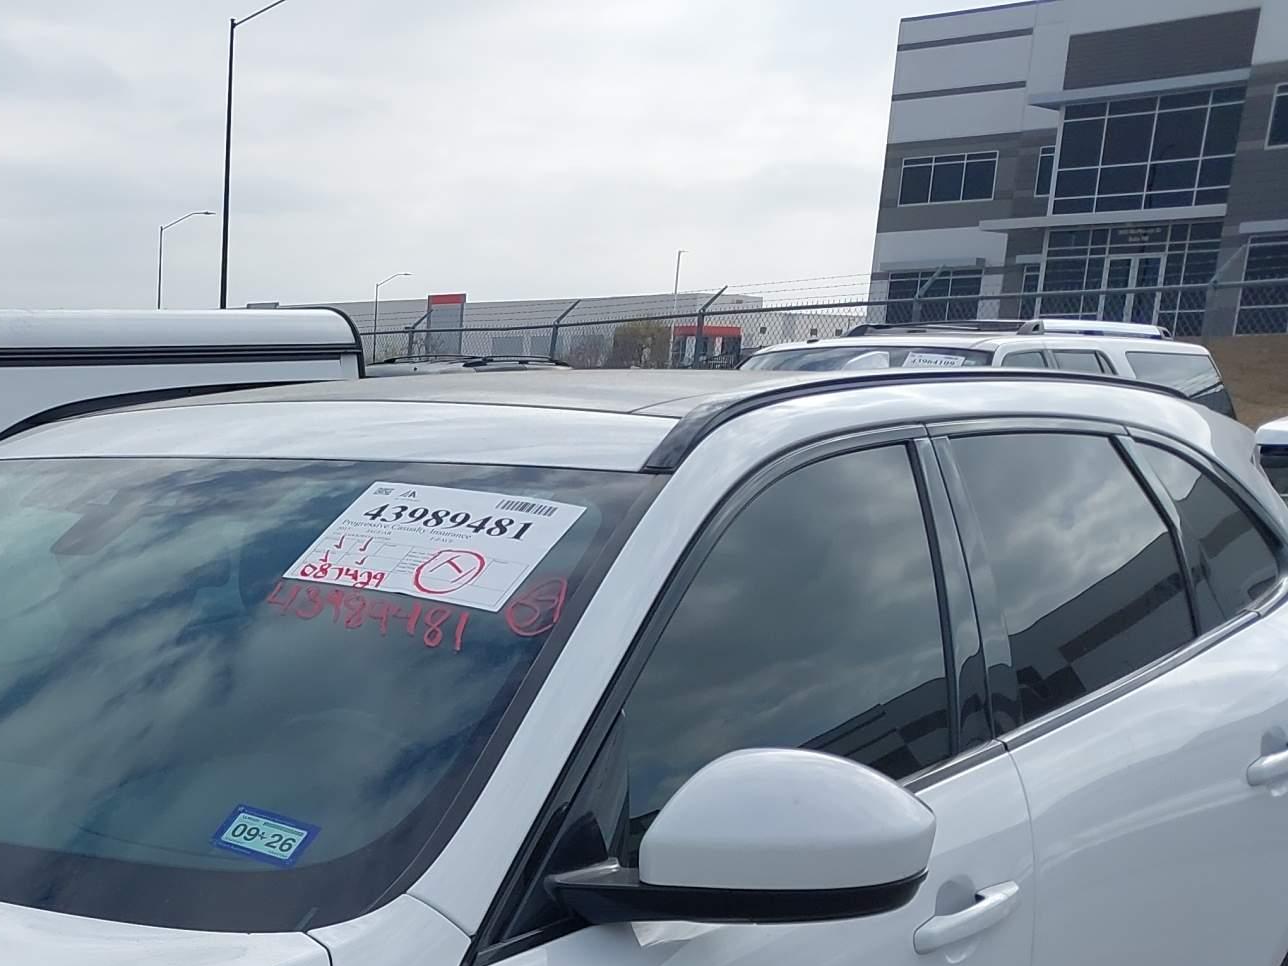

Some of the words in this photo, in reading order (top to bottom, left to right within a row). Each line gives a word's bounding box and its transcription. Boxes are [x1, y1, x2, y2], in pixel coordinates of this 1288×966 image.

[364, 503, 533, 541] 43989481
[430, 528, 472, 540] Insurance
[264, 834, 296, 852] 26
